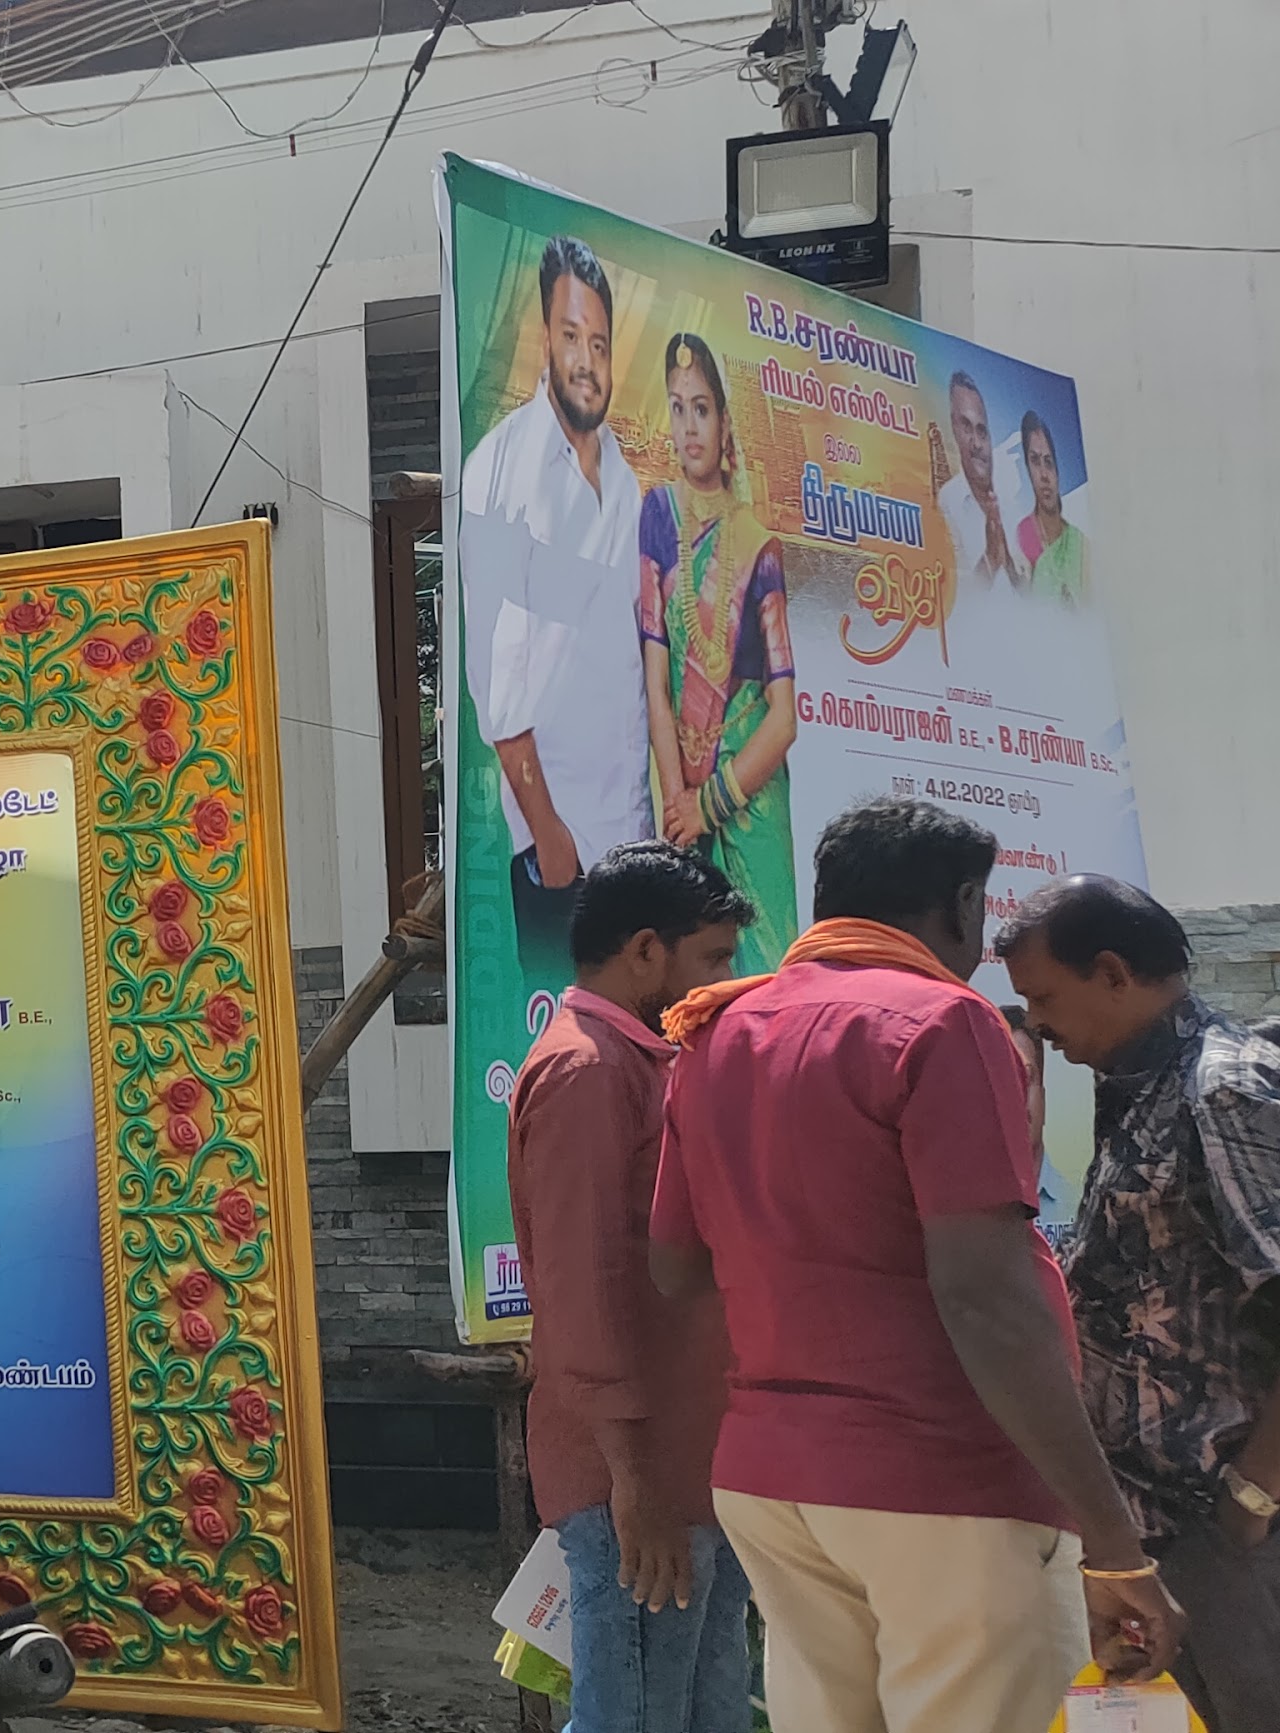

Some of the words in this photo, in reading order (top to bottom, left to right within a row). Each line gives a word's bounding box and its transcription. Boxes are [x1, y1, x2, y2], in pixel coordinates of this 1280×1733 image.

[744, 291, 918, 388] R.B.சரண்யா
[760, 356, 825, 411] ரியல்
[828, 382, 921, 440] எஸ்டேட்
[801, 460, 925, 550] திருமண
[838, 552, 950, 668] விழா
[797, 691, 953, 745] G.கொம்பராஜன்
[998, 724, 1088, 768] B.சரண்யா
[925, 778, 1006, 808] 4.12.2022
